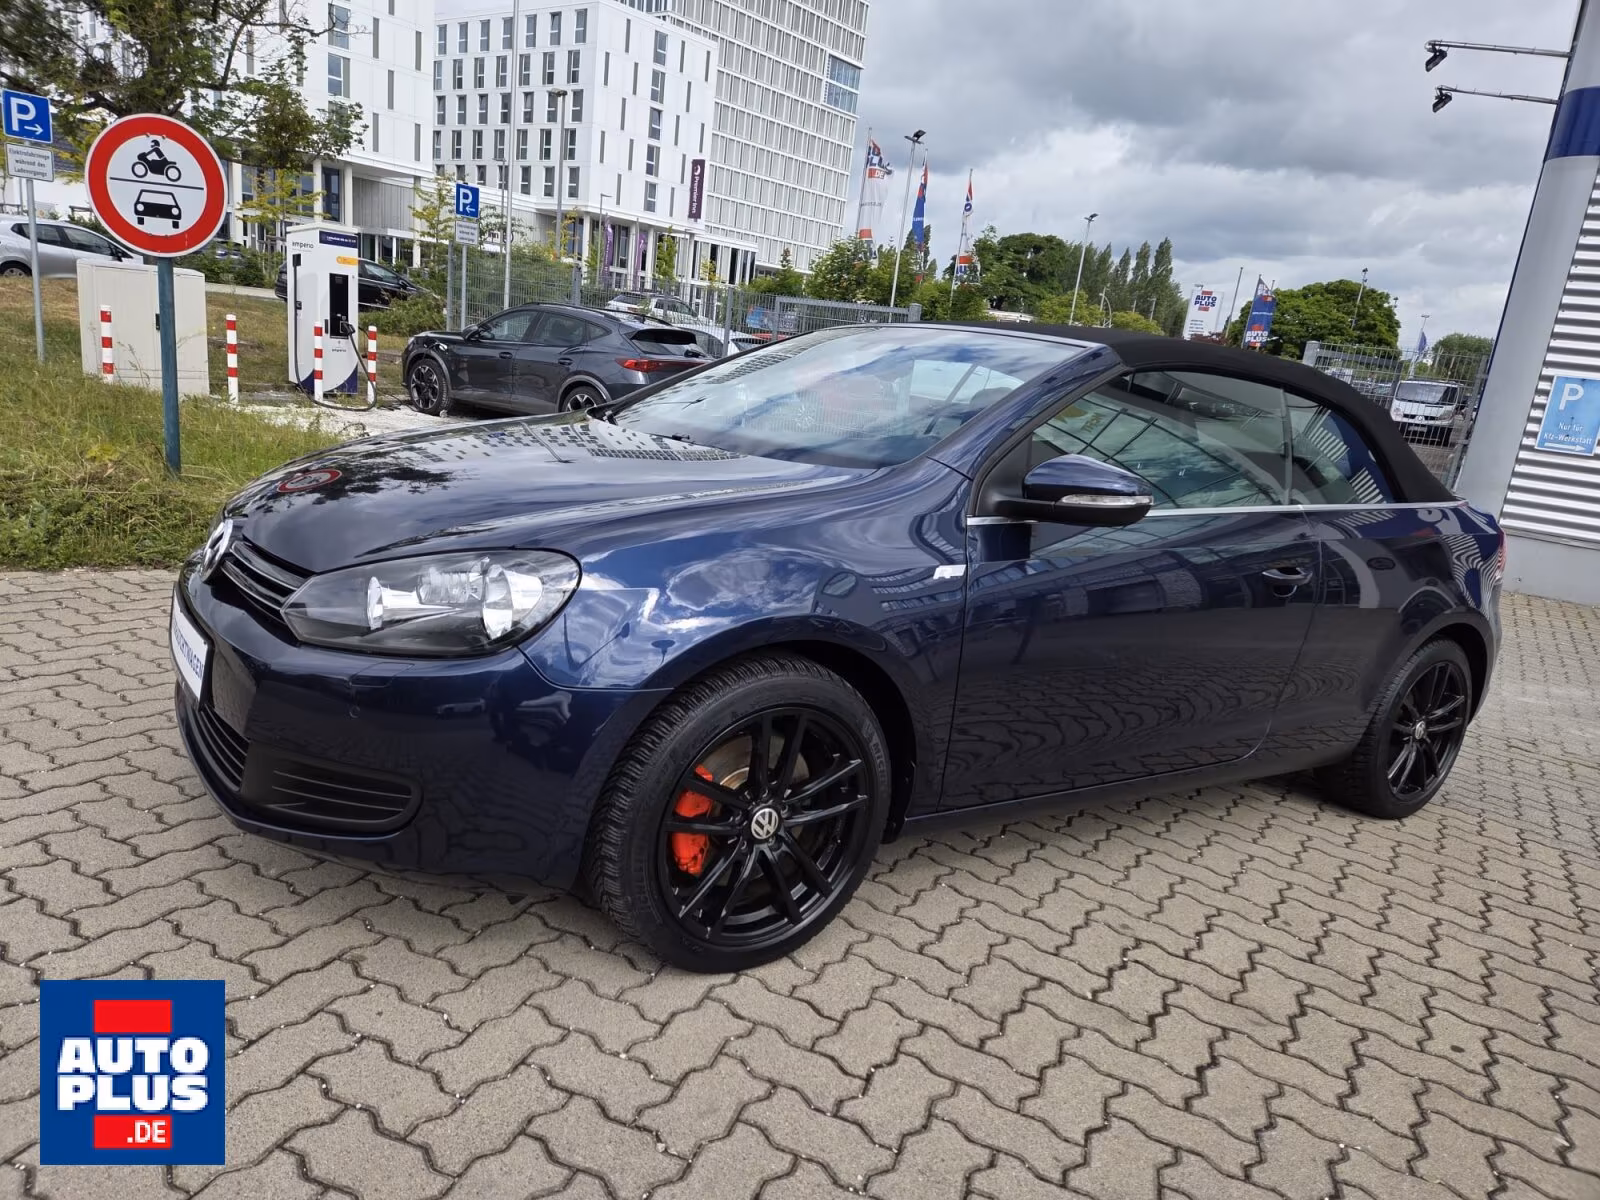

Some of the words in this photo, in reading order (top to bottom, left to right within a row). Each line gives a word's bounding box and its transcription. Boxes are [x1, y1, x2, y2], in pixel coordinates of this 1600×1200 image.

[10, 96, 36, 131] P
[692, 176, 700, 203] Premier
[459, 187, 473, 212] P
[1194, 300, 1216, 308] PLUS
[1195, 294, 1217, 302] AUTO
[1559, 383, 1584, 411] P
[1558, 421, 1571, 430] Nur
[1573, 422, 1584, 432] für
[1543, 433, 1593, 445] Kfz-Werkstatt
